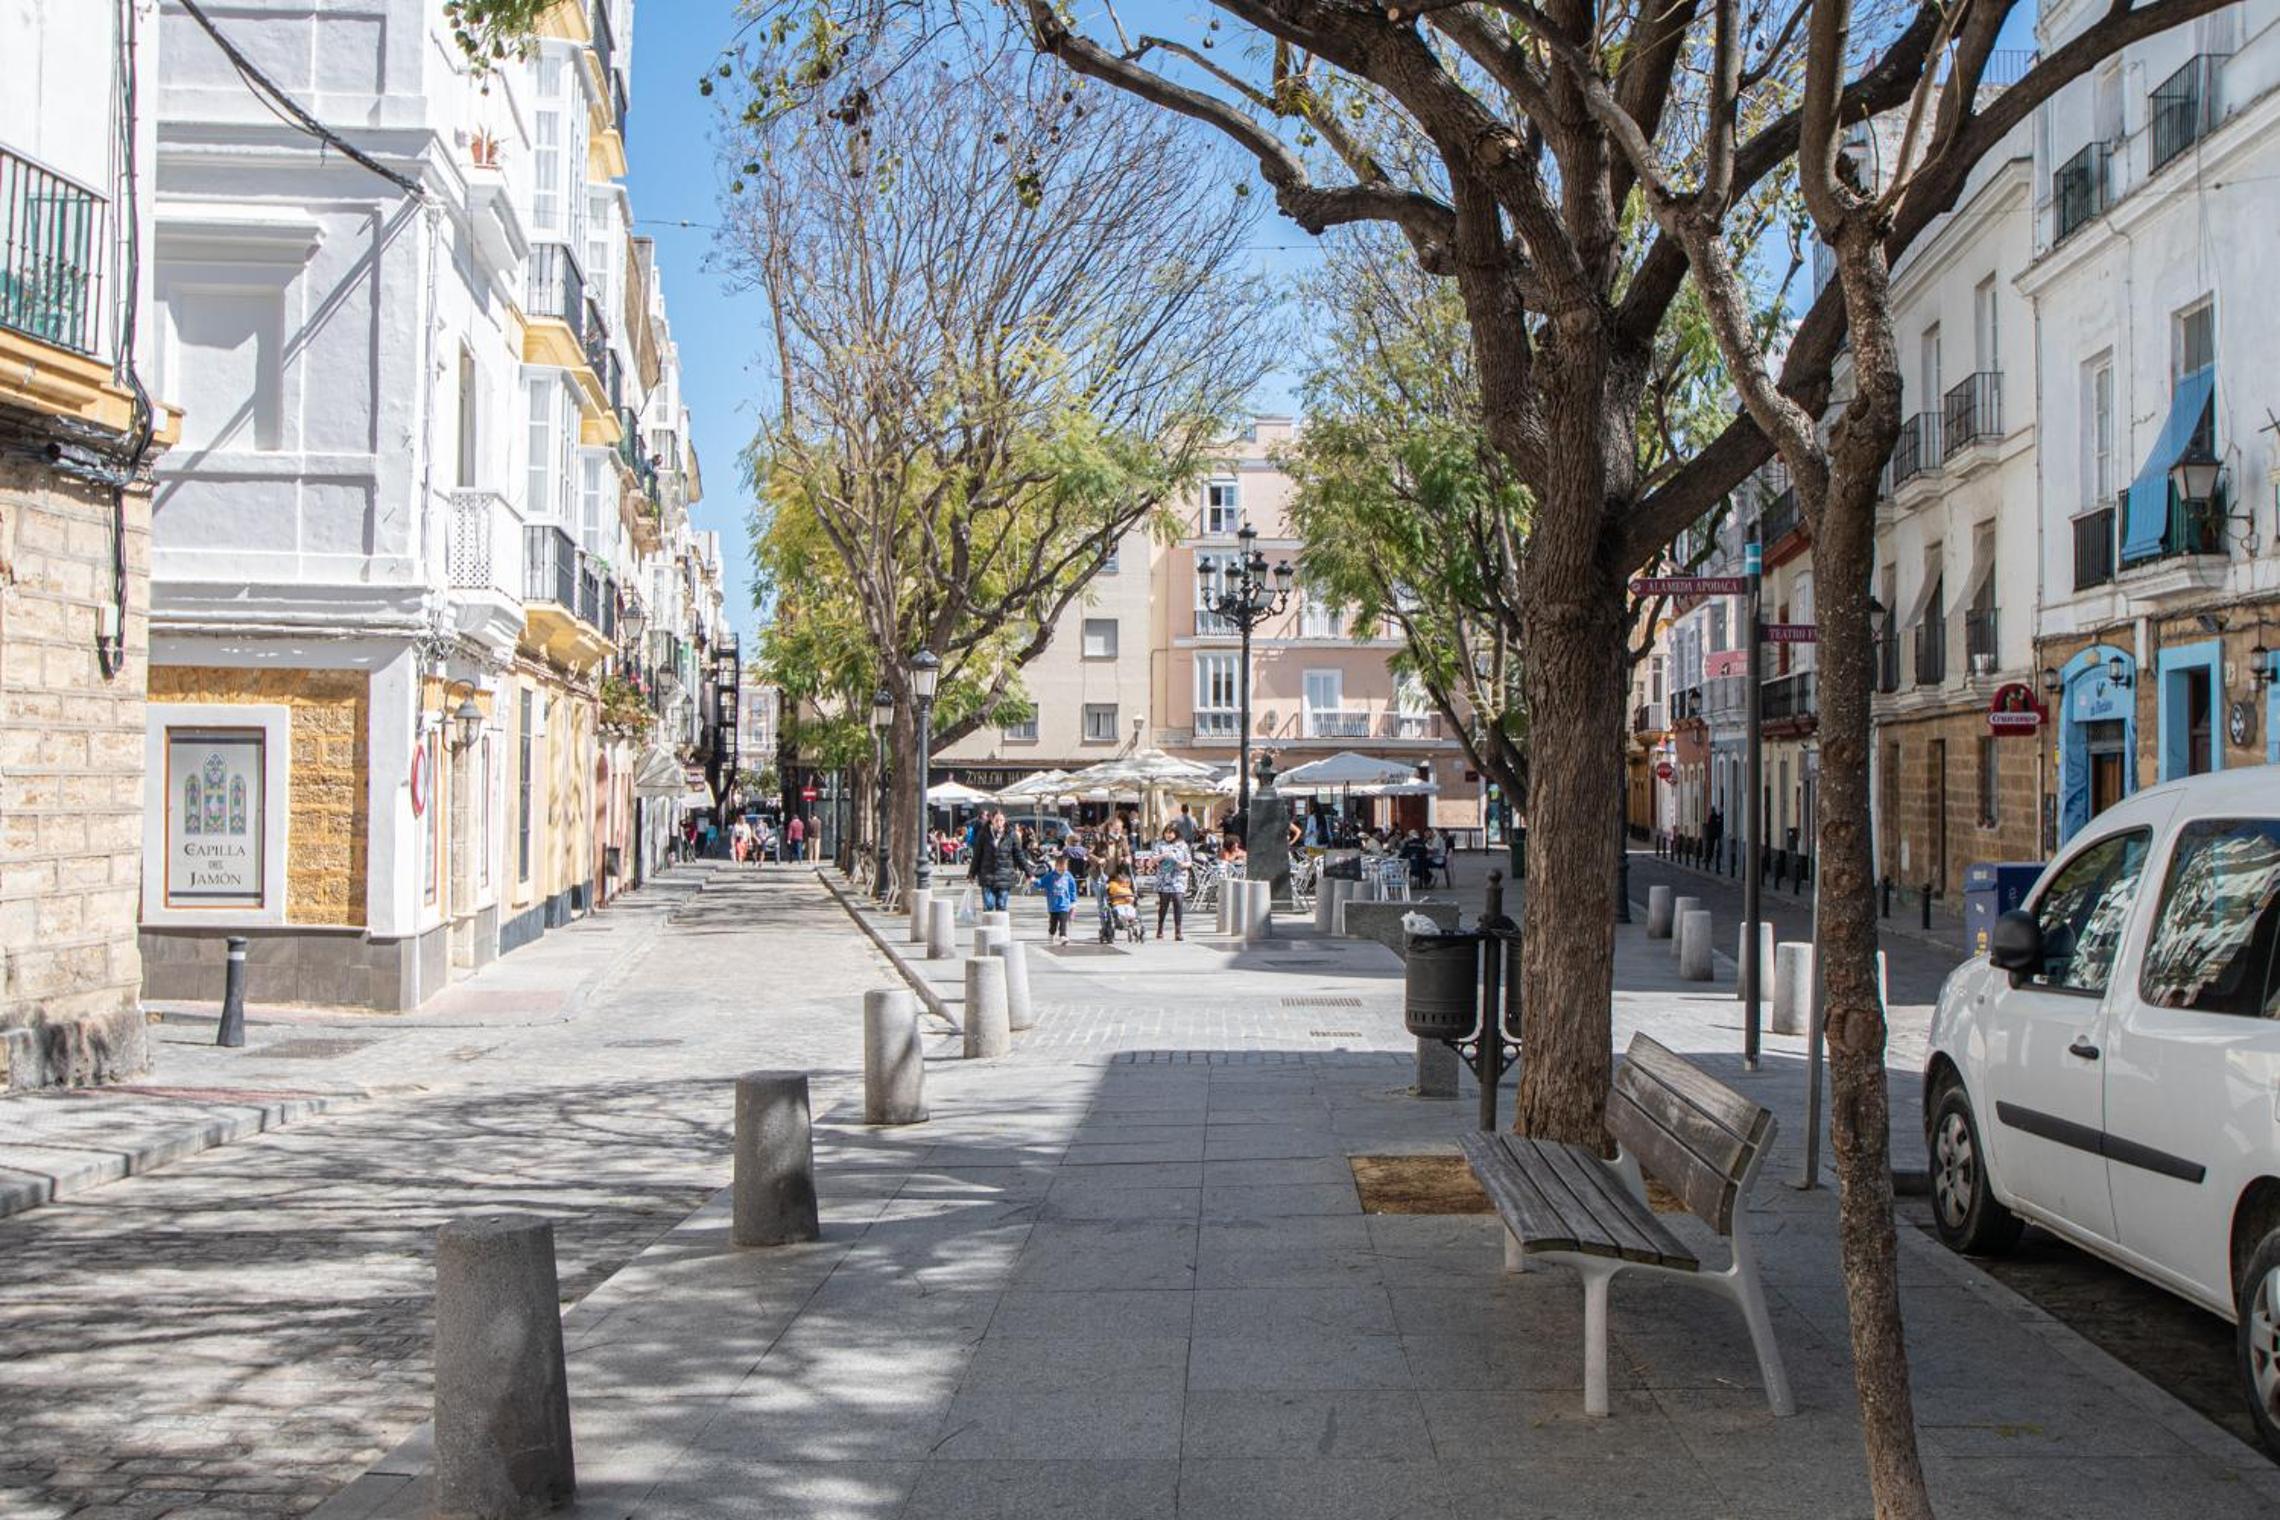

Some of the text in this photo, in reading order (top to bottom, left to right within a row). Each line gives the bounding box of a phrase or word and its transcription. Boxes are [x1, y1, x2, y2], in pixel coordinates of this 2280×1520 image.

[1649, 579, 1738, 593] ALAMEDA APODACA
[1768, 628, 1806, 640] TEATRO
[184, 842, 246, 857] CAPILLA
[208, 859, 224, 870] DEL
